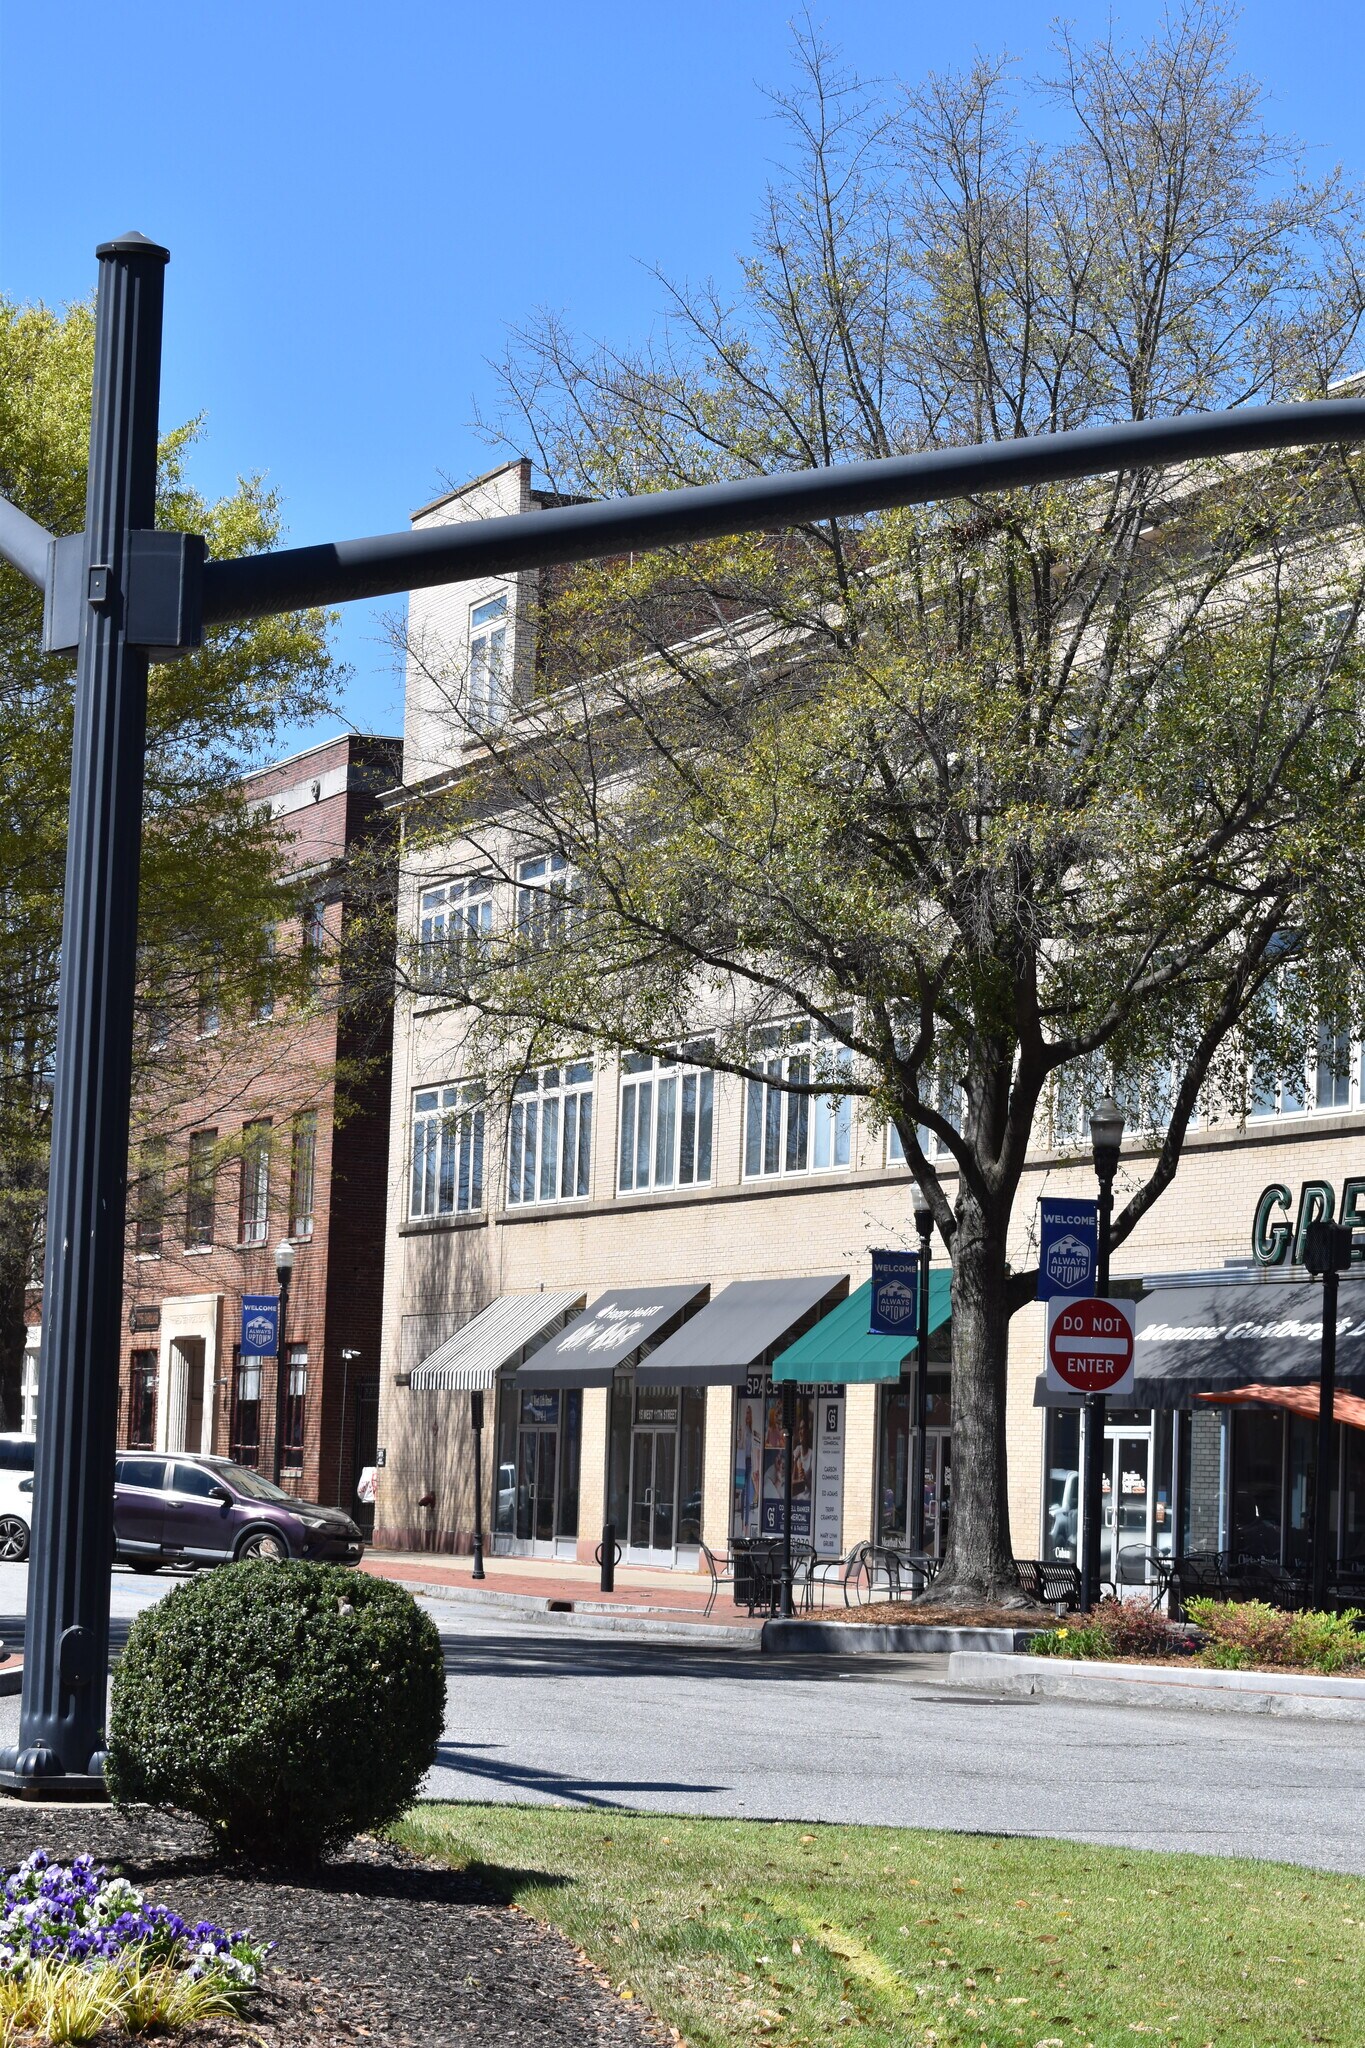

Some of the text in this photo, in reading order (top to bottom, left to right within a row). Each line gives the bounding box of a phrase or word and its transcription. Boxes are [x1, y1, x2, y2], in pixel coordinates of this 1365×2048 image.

[1043, 1214, 1095, 1226] WELCOME
[1051, 1256, 1087, 1266] ALWAYS
[874, 1263, 917, 1273] WELCOME
[1050, 1265, 1087, 1284] UPTOWN
[244, 1304, 277, 1312] WELCOME
[881, 1298, 910, 1306] ALWAYS
[880, 1305, 910, 1320] UPTOWN
[1063, 1316, 1122, 1333] DO NOT
[1134, 1323, 1228, 1341] Momma
[248, 1334, 272, 1345] UPTOWN
[1067, 1357, 1114, 1374] ENTER
[746, 1378, 779, 1395] SPACE
[643, 1409, 654, 1420] WEST
[663, 1409, 678, 1420] STREET
[1055, 1546, 1071, 1559] Cuban
